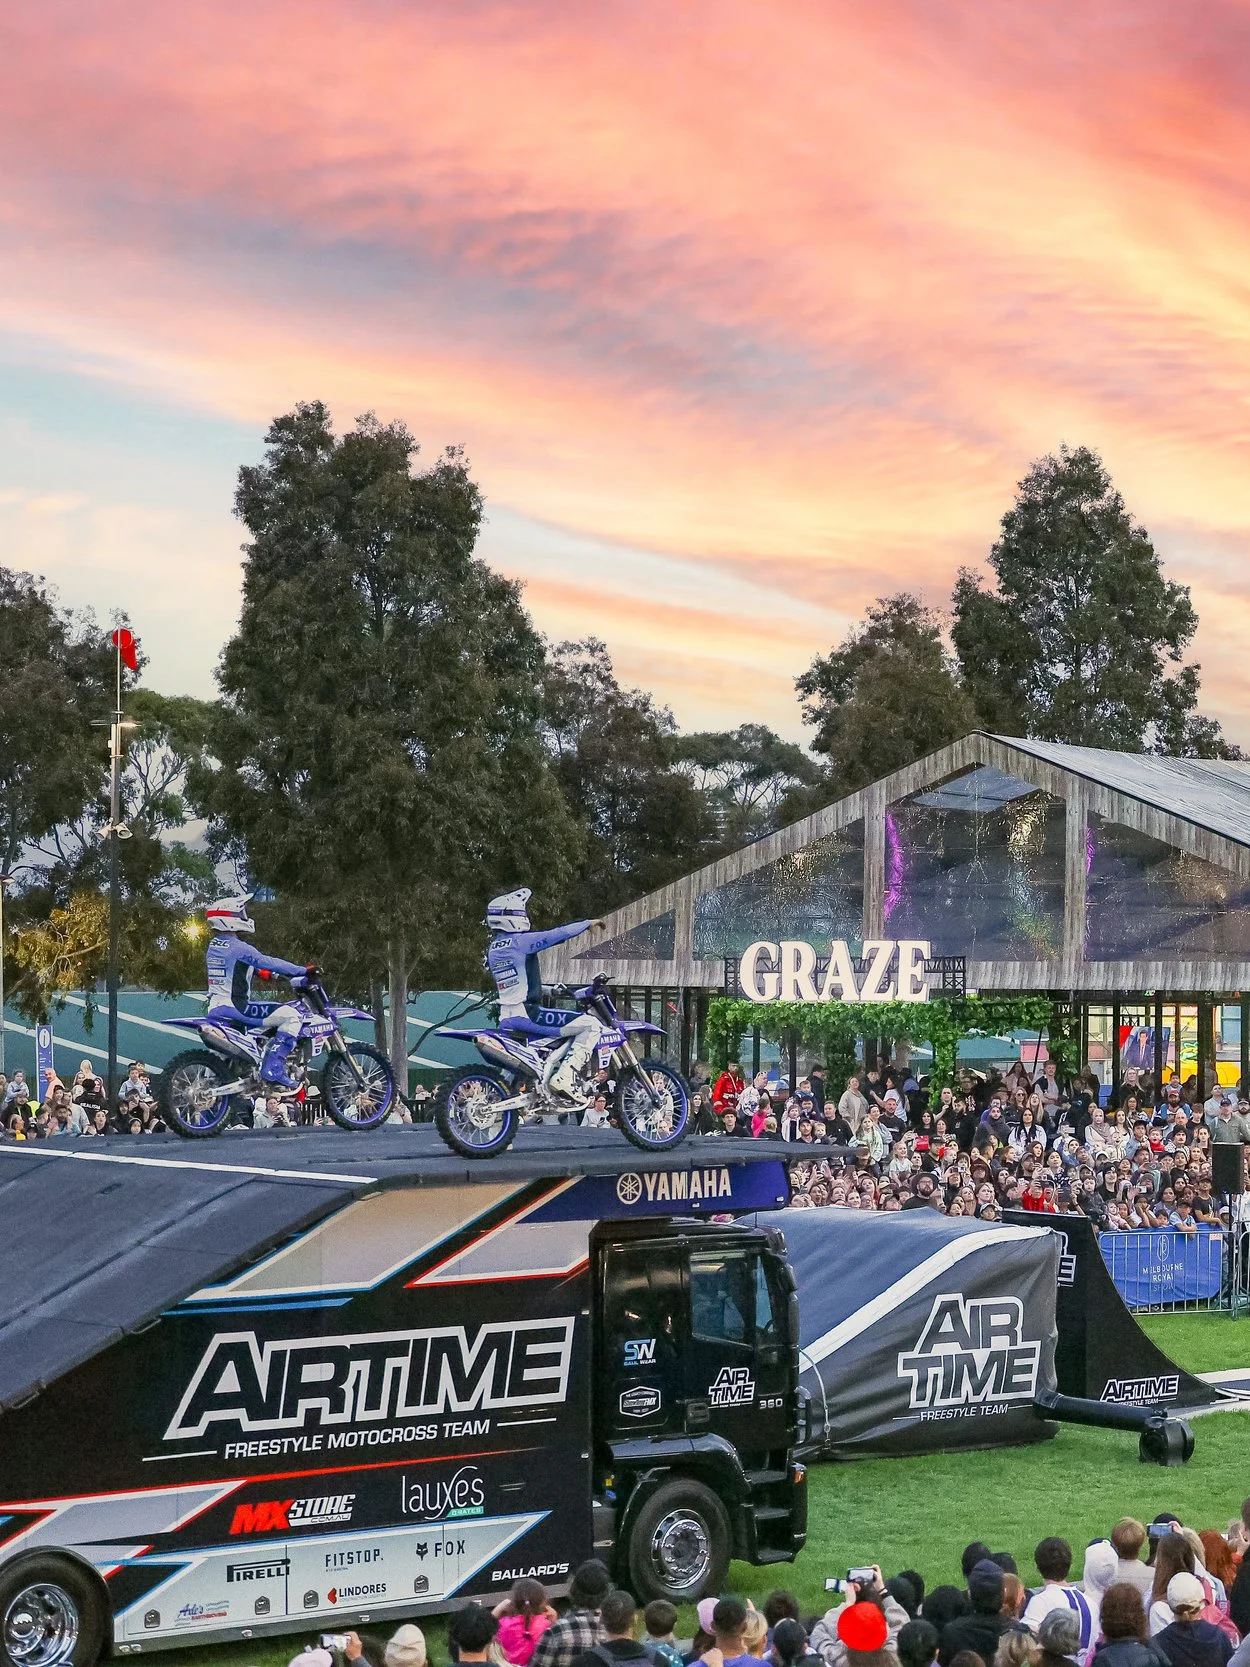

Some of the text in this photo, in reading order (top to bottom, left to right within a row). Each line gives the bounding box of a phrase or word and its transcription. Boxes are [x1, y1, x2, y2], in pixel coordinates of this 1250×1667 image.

[740, 940, 931, 1001] GRAZE
[644, 1168, 732, 1201] YAMAHA
[913, 1293, 1024, 1354] AIR
[624, 1338, 656, 1361] SW
[163, 1316, 575, 1440] AIRTIME
[713, 1367, 749, 1387] AIR
[898, 1340, 1041, 1408] TIME
[708, 1381, 755, 1405] TIME
[1100, 1375, 1179, 1402] AIRTIME
[760, 1398, 783, 1409] 360
[920, 1404, 1009, 1421] FREESTYLE TEAM
[224, 1419, 490, 1459] FREESTYLE MOTOCROSS TEAM
[402, 1466, 485, 1519] lauxes
[229, 1494, 356, 1535] MX STORE
[434, 1540, 466, 1557] FOX
[227, 1558, 291, 1583] PIRELLI
[491, 1563, 569, 1581] BALLARD'S
[339, 1583, 386, 1597] LINDORES
